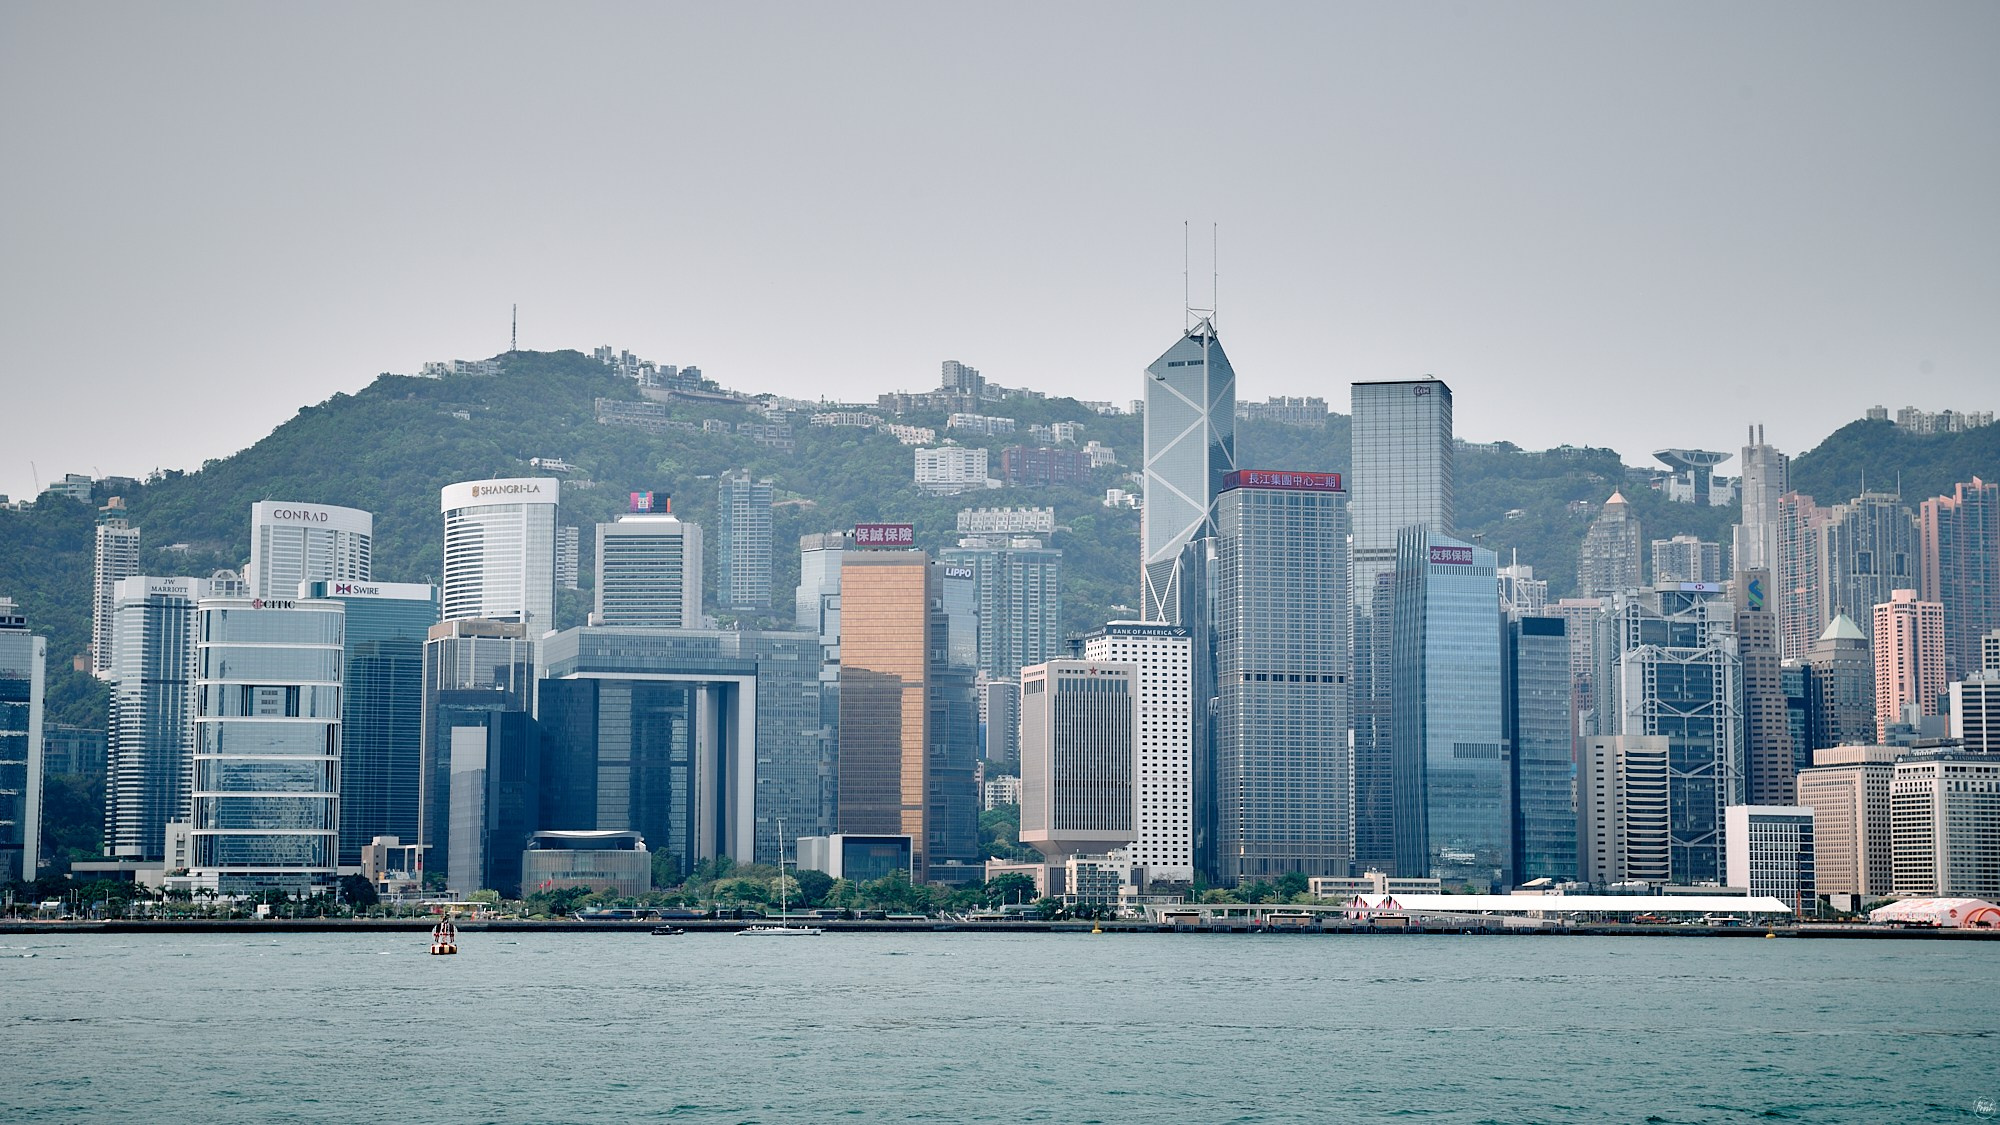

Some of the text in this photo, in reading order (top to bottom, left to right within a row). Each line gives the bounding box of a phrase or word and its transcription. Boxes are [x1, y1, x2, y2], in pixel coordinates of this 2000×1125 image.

[1249, 473, 1336, 488] 長江集團中心二期
[481, 484, 540, 495] SHANGRI-LA
[273, 509, 329, 522] CONRAD
[855, 527, 913, 542] 保誠保險
[1430, 549, 1472, 562] 友邦保險
[945, 567, 972, 578] LIPPO
[150, 585, 189, 593] MARRIOTT
[263, 600, 296, 609] CITIC
